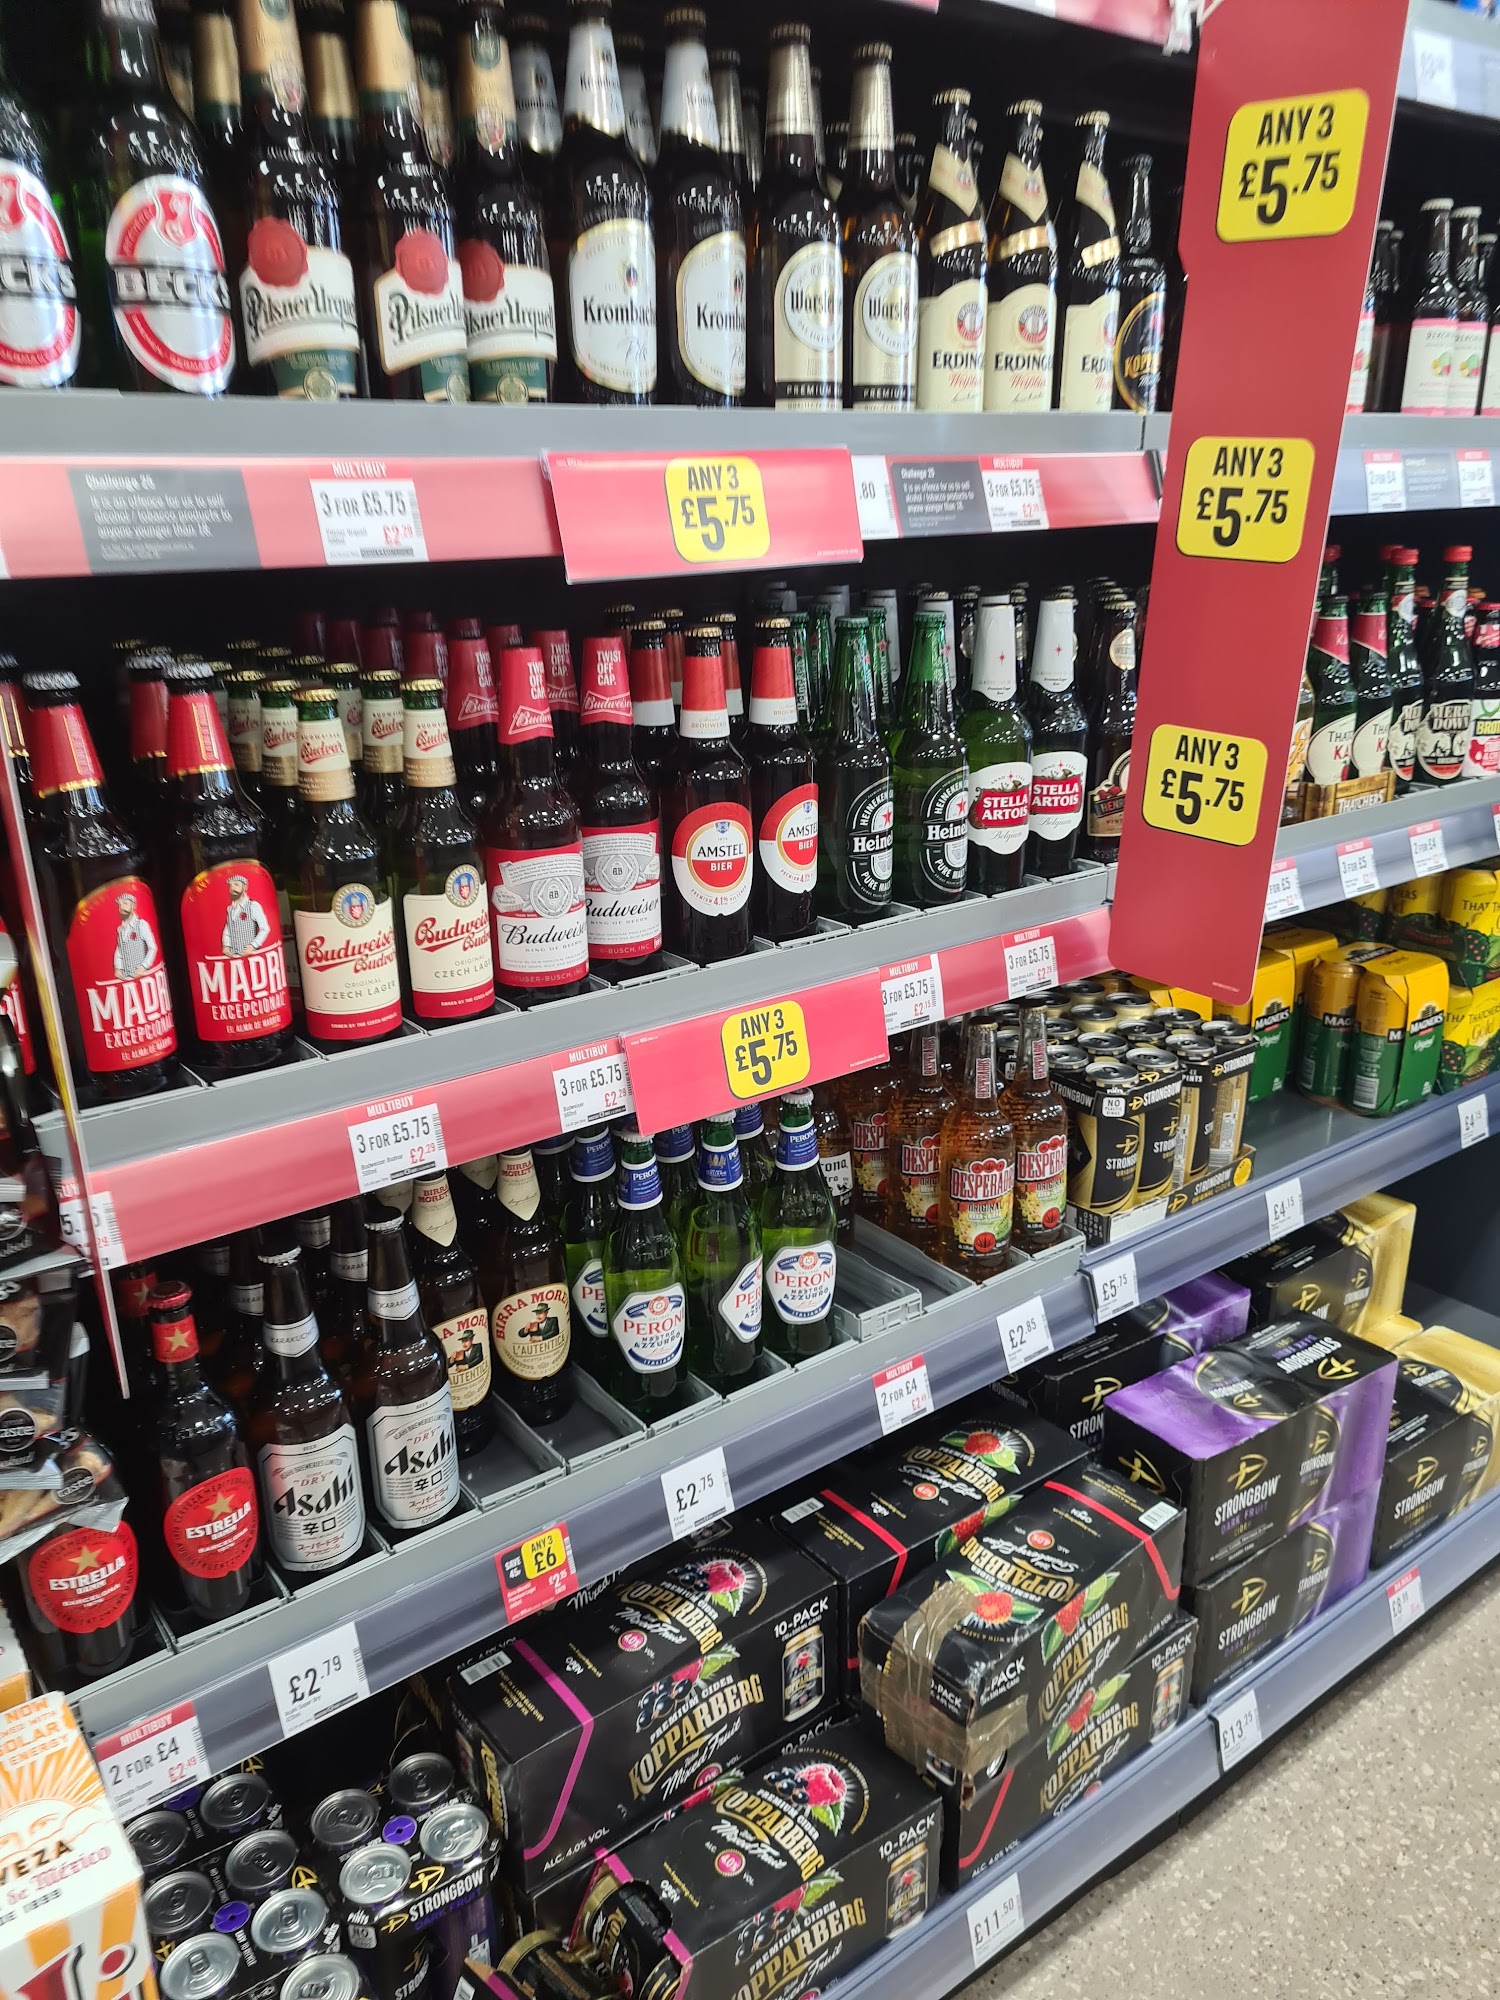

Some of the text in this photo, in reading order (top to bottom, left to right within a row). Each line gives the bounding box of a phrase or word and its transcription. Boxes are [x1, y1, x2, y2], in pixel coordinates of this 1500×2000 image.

[1256, 103, 1336, 149] ANY 3
[1238, 150, 1341, 226] £5.75
[331, 461, 387, 479] MULTIBUY
[1213, 446, 1284, 478] ANY 3
[687, 465, 740, 492] ANY 3
[987, 478, 1035, 497] 3 FOR £5.75
[320, 489, 407, 517] 3 FOR £5.75
[1196, 487, 1290, 547] £5.75
[680, 495, 756, 553] £5.75
[596, 650, 622, 663] TWIST
[596, 664, 614, 674] OFF
[1175, 734, 1240, 770] ANY 3
[982, 793, 1029, 809] STELLA
[1031, 793, 1080, 807] ARTOIS
[1032, 782, 1080, 795] STELLA
[1160, 769, 1246, 825] £5.75
[981, 805, 1029, 821] ARTOIS
[697, 843, 743, 858] AMSTEL
[798, 840, 814, 851] BIER
[710, 861, 733, 871] BIER
[934, 857, 952, 878] PURE
[861, 871, 880, 890] PURE
[1013, 928, 1041, 944] MULTIBUY
[889, 960, 919, 977] MULTIBUY
[1008, 944, 1050, 970] 3 FOR £5.75
[344, 977, 382, 989] ORIGINAL
[434, 967, 471, 979] CZECH
[323, 980, 396, 1000] CZECH LAGER
[882, 978, 929, 1006] 3 FOR £5.75
[740, 1008, 784, 1041] ANY 3
[1255, 1009, 1291, 1029] MAGNERS
[1409, 1012, 1445, 1034] MAGNERS
[568, 1044, 608, 1064] MULTIBUY
[735, 1030, 798, 1085] £5.75
[1223, 1051, 1255, 1074] STRONGBOW
[560, 1063, 622, 1097] 3 FOR £5.75
[976, 1058, 991, 1098] DESPERADOS
[366, 1094, 414, 1118] MULTIBUY
[604, 1087, 627, 1108] £2.29
[1050, 1080, 1094, 1108] STRONGBOW
[1107, 1099, 1121, 1107] NO
[1143, 1080, 1182, 1106] STRONGBOW
[356, 1115, 430, 1154] 3 FOR £5.75
[409, 1142, 436, 1165] £2.29
[506, 1160, 533, 1172] BIRRA
[1194, 1168, 1232, 1196] STRONGBOW
[1273, 1195, 1296, 1220] £4.15
[783, 1286, 830, 1300] AZZURRO
[791, 1284, 824, 1294] NASTRO
[1102, 1273, 1128, 1302] £5.75
[495, 1297, 529, 1341] BIRRA
[633, 1331, 681, 1349] AZZURRO
[641, 1328, 675, 1343] NASTRO
[1008, 1317, 1037, 1350] £2.85
[885, 1360, 913, 1381] MULTIBUY
[880, 1378, 918, 1407] 2 FOR £4
[902, 1446, 1005, 1503] KOPPARBERG
[273, 1464, 355, 1518] Asahi
[675, 1473, 714, 1513] £2.75
[1214, 1475, 1279, 1527] STRONGBOW
[1394, 1476, 1447, 1520] STRONGBOW
[185, 1501, 251, 1540] ESTRELLA
[531, 1535, 554, 1554] ANY 3
[49, 1555, 127, 1591] ESTRELLA
[504, 1555, 522, 1571] SAVE
[534, 1546, 557, 1573] £6
[618, 1580, 723, 1654] KOPPARBERG
[774, 1596, 829, 1638] 10-PACK
[1218, 1597, 1279, 1650] STRONGBOW
[1038, 1601, 1129, 1725] KOPPARBERG
[1151, 1632, 1192, 1669] 10-PACK
[288, 1655, 342, 1705] £2.79
[5, 1697, 48, 1723] NOW
[649, 1674, 734, 1743] PREMIUM CIDER
[120, 1713, 173, 1747] MULTIBUY
[628, 1673, 765, 1800] KOPPARBERG
[109, 1736, 181, 1786] 2 FOR £4
[1039, 1701, 1139, 1814] KOPPARBERG
[757, 1788, 819, 1842] PREMIUM CIDER
[566, 1839, 588, 1861] 4.0%
[588, 1826, 610, 1845] VOL
[713, 1787, 826, 1879] KOPPARBERG
[878, 1812, 936, 1858] 10-PACK
[410, 1869, 484, 1923] STRONGBOW
[660, 1879, 681, 1903] OPEN
[974, 1897, 1014, 1946] £11.50
[749, 1900, 837, 1975] PREMIUM CIDER
